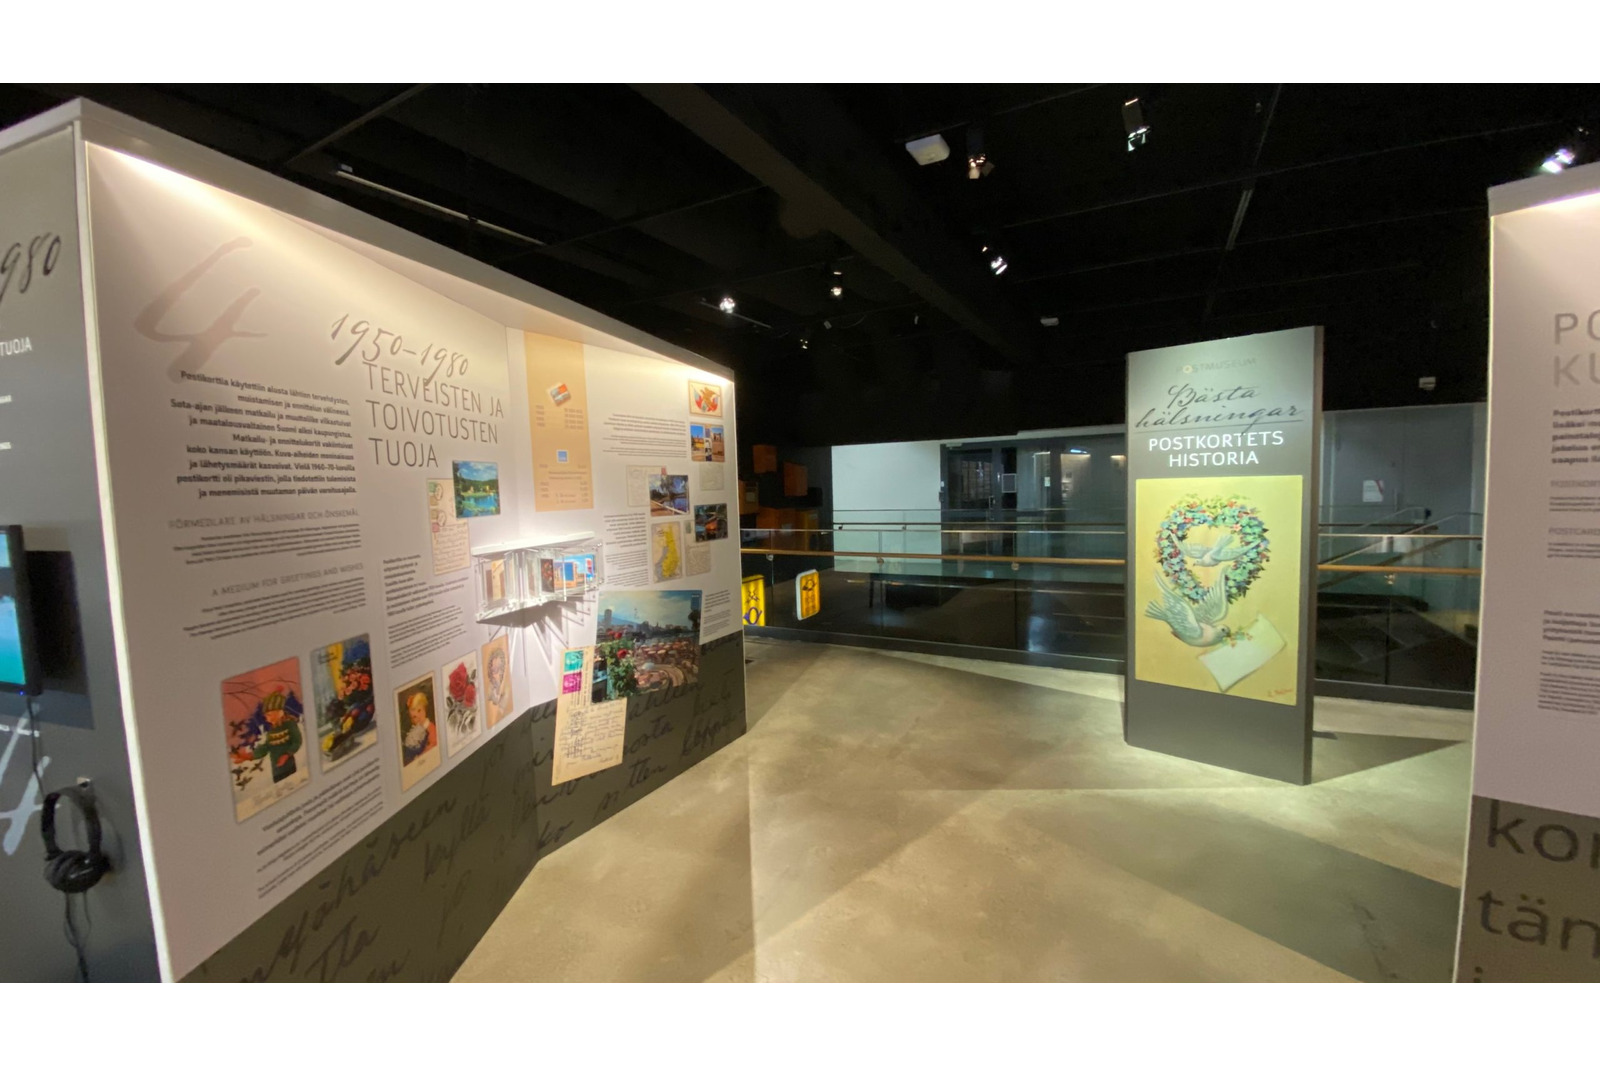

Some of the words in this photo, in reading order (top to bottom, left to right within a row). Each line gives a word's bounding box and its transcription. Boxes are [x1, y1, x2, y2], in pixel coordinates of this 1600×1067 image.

[362, 361, 482, 414] TERVEISTEN
[490, 396, 504, 419] JA
[1167, 383, 1260, 409] Bästa
[189, 415, 198, 426] ja
[365, 399, 498, 444] TOIVOTUSTEN
[1135, 404, 1302, 436] hälsningar
[1149, 430, 1284, 451] POSTKORTETS
[368, 437, 438, 468] TUOJA
[1169, 451, 1259, 467] HISTORIA
[189, 459, 198, 470] ja
[198, 488, 207, 499] ja
